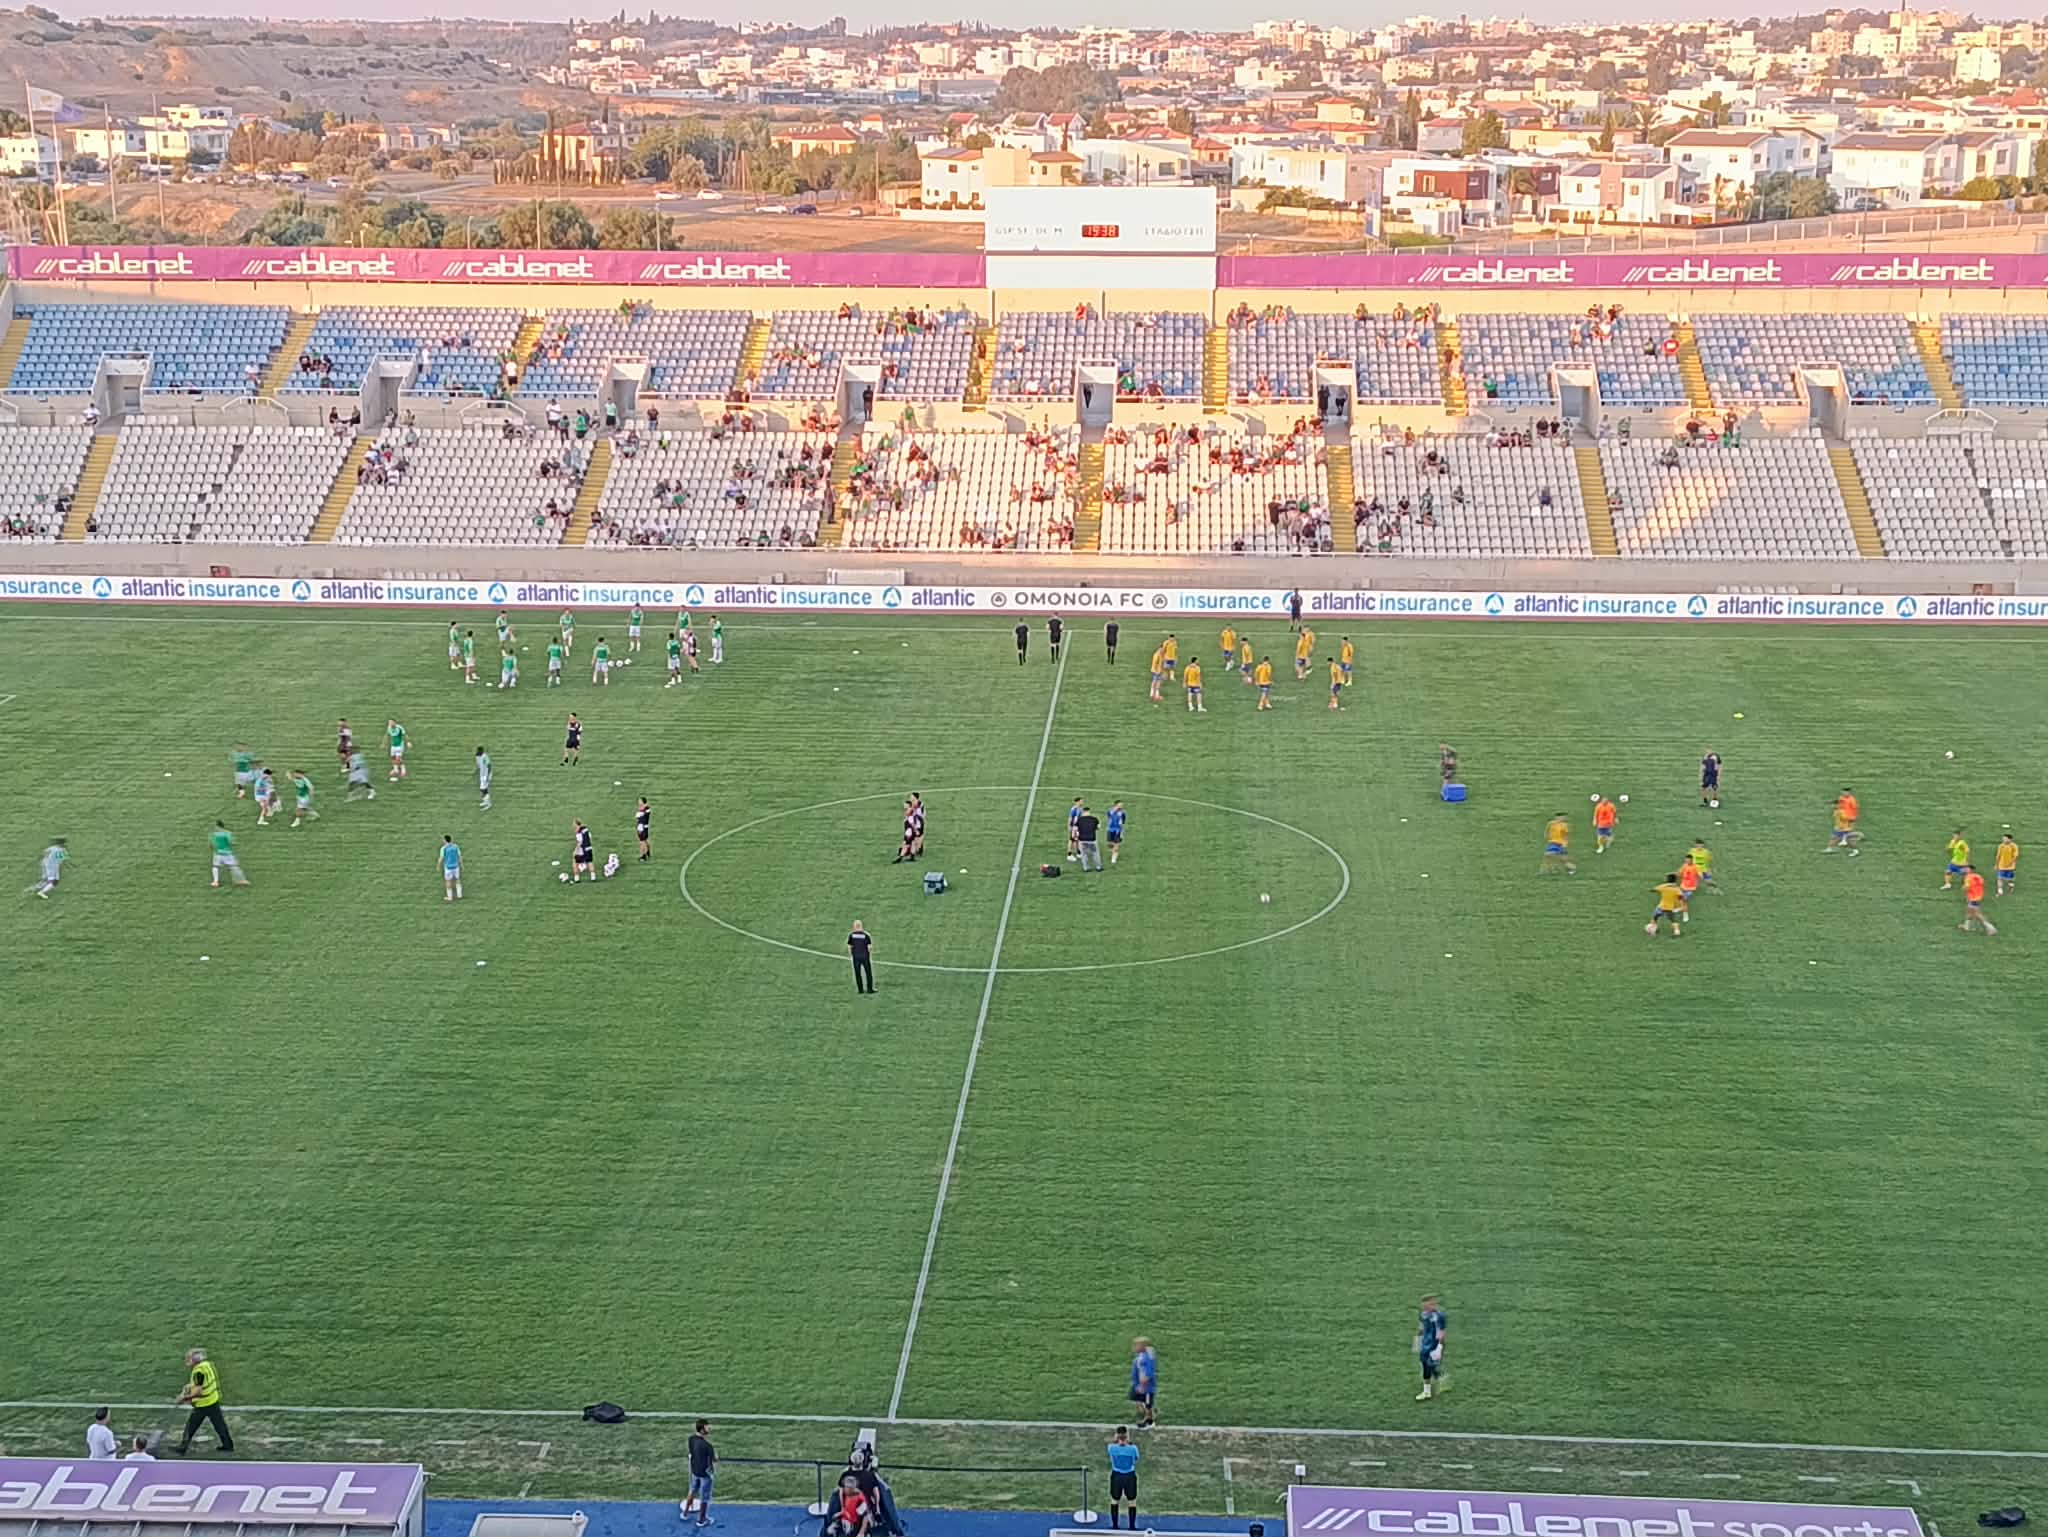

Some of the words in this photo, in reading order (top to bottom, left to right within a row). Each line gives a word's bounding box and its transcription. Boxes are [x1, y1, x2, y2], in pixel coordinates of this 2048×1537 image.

[59, 252, 192, 275] cablenet
[267, 253, 395, 276] cablenet
[467, 255, 593, 278] cablenet
[664, 257, 791, 280] cablenet
[1443, 260, 1574, 283] cablenet
[1648, 259, 1781, 282] cablenet
[1856, 258, 1994, 281] cablenet
[122, 579, 185, 597] atlantic
[188, 580, 281, 599] insurance
[321, 582, 384, 600] atlantic
[387, 583, 478, 601] insurance
[517, 584, 579, 602] atlantic
[583, 585, 674, 603] insurance
[714, 586, 777, 604] atlantic
[781, 588, 872, 605] insurance
[911, 588, 975, 606] atlantic
[1014, 591, 1113, 606] OMONOIA
[1120, 593, 1144, 607] FC
[1179, 591, 1272, 610] insurance
[1311, 592, 1376, 611] atlantic
[1379, 594, 1473, 612] insurance
[1514, 594, 1579, 613] atlantic
[1582, 595, 1677, 614] insurance
[1717, 596, 1784, 615] atlantic
[1787, 598, 1884, 616] insurance
[1926, 597, 1995, 616] atlantic
[1368, 1500, 1715, 1537] cablenet
